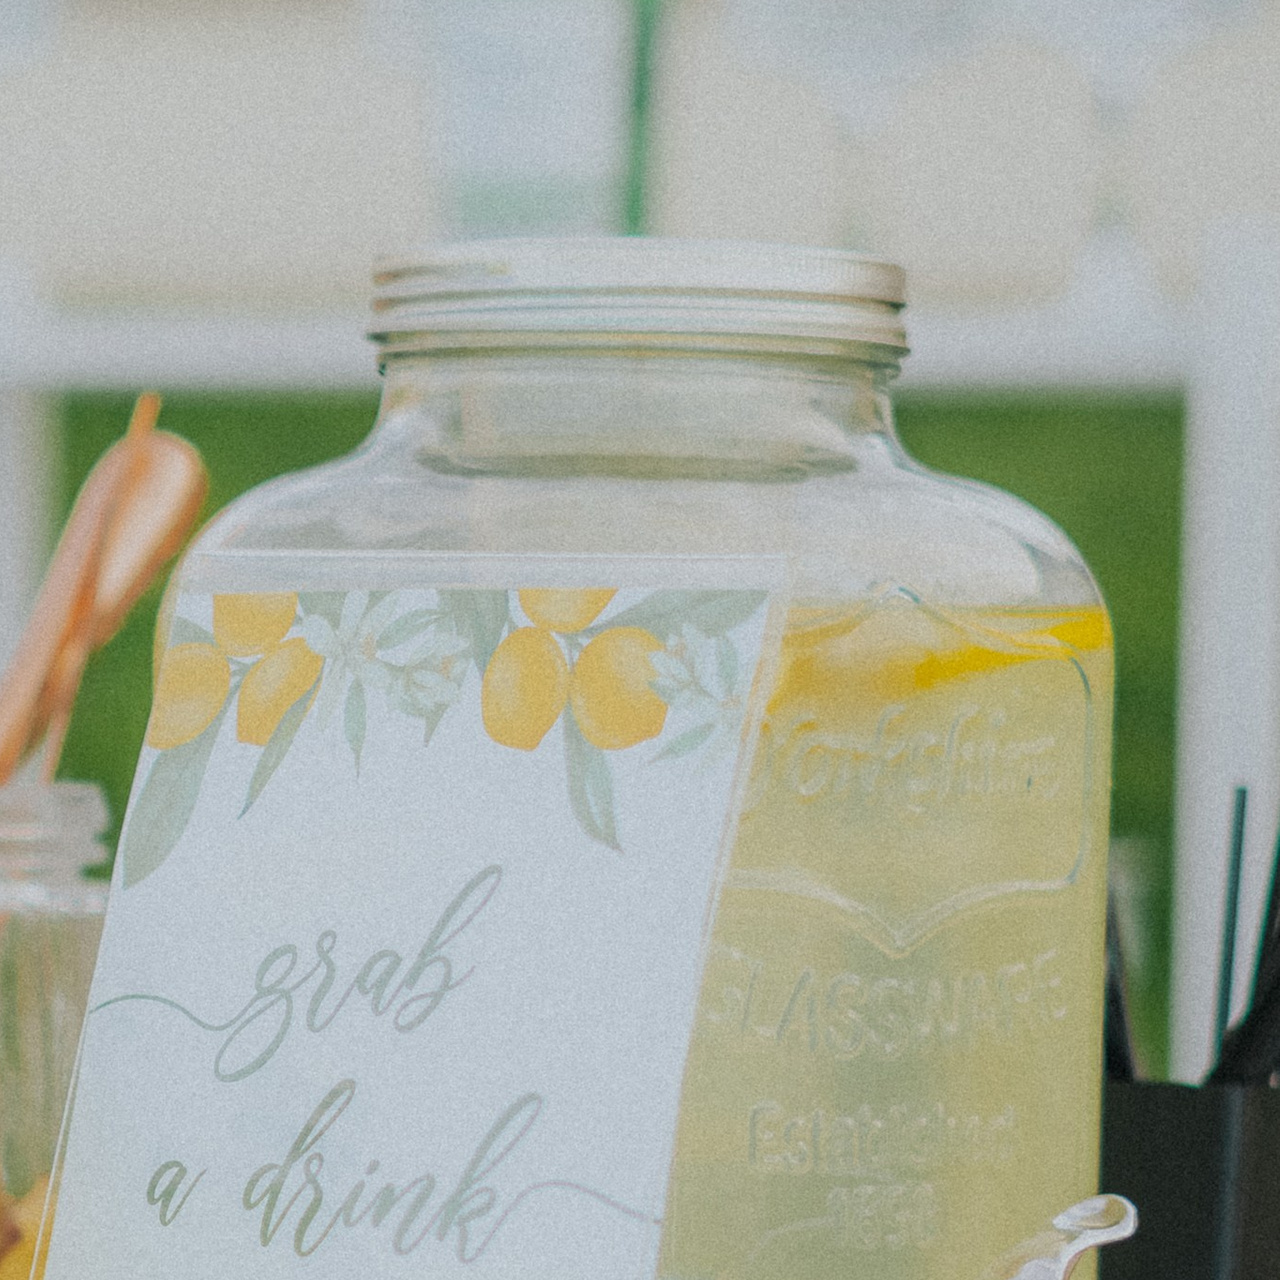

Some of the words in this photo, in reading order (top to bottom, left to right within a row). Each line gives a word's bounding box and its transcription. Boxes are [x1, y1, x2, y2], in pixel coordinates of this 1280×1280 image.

[89, 864, 503, 1083] grab
[147, 1159, 208, 1227] a
[242, 1078, 663, 1264] drink
